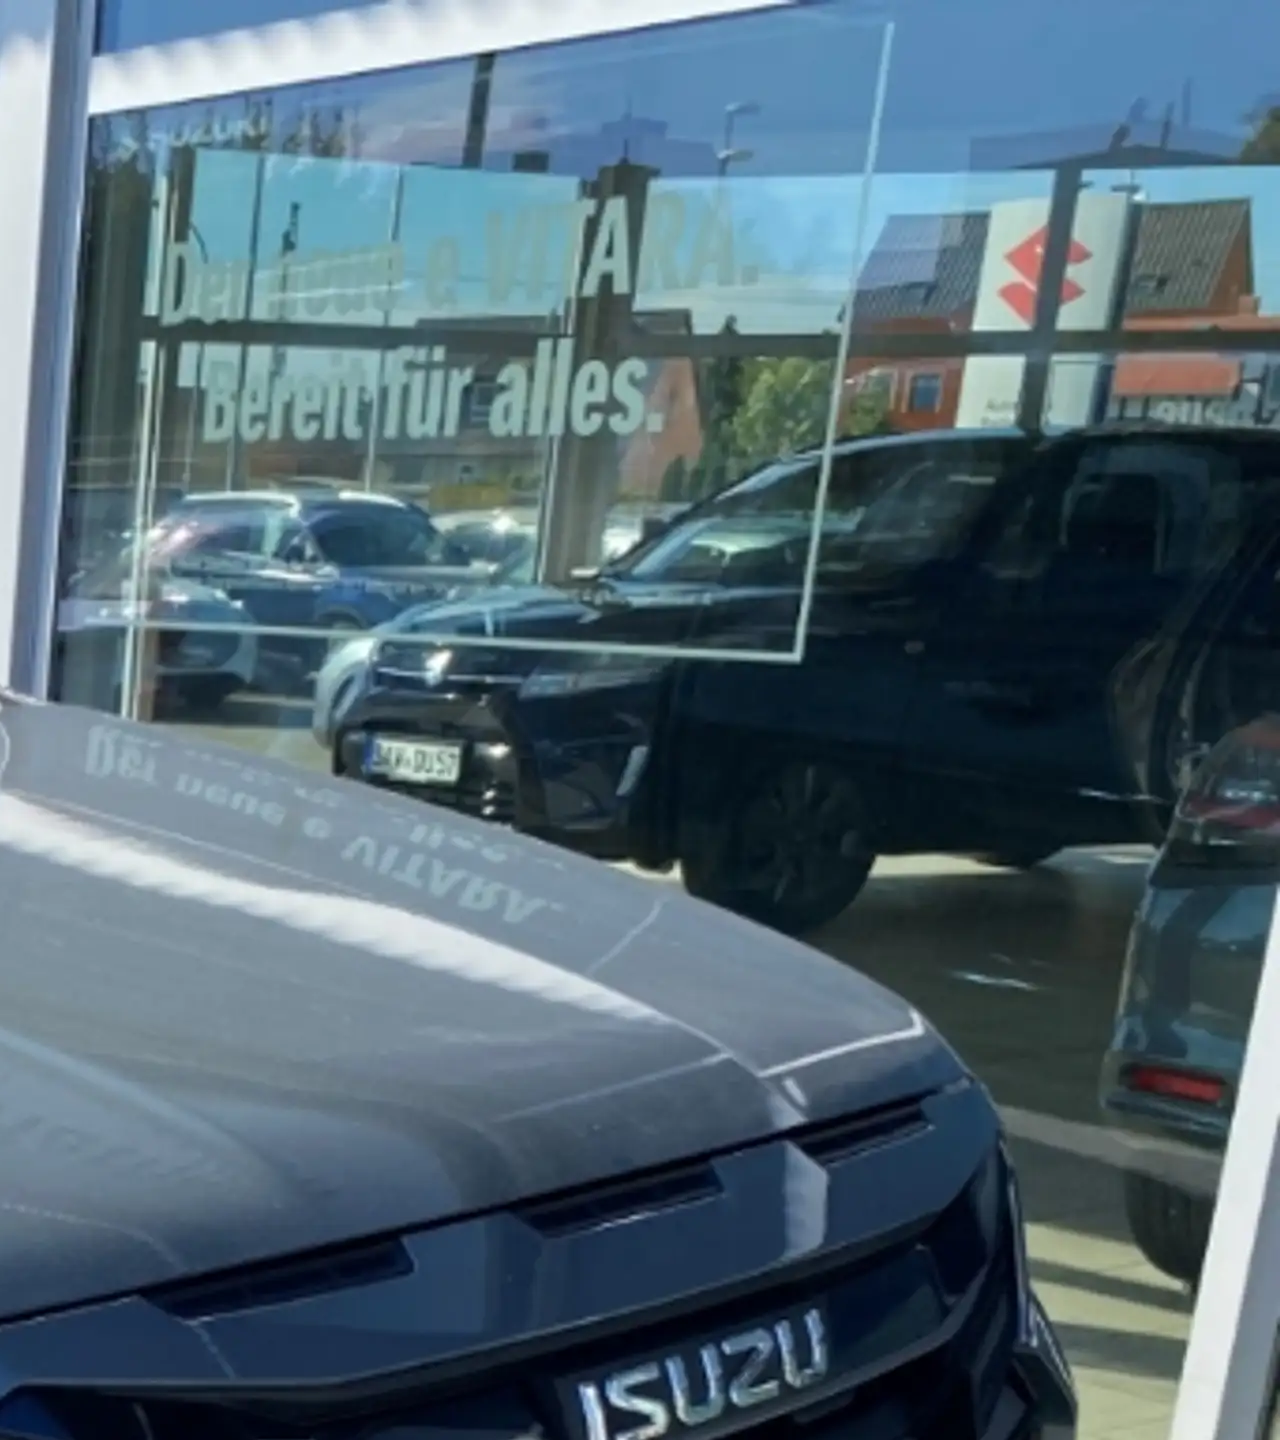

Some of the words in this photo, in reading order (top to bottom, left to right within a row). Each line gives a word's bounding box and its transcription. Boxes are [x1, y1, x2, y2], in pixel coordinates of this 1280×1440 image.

[159, 239, 249, 327] Der
[201, 354, 367, 444] Bereit
[380, 342, 475, 440] für
[487, 336, 665, 439] alles.
